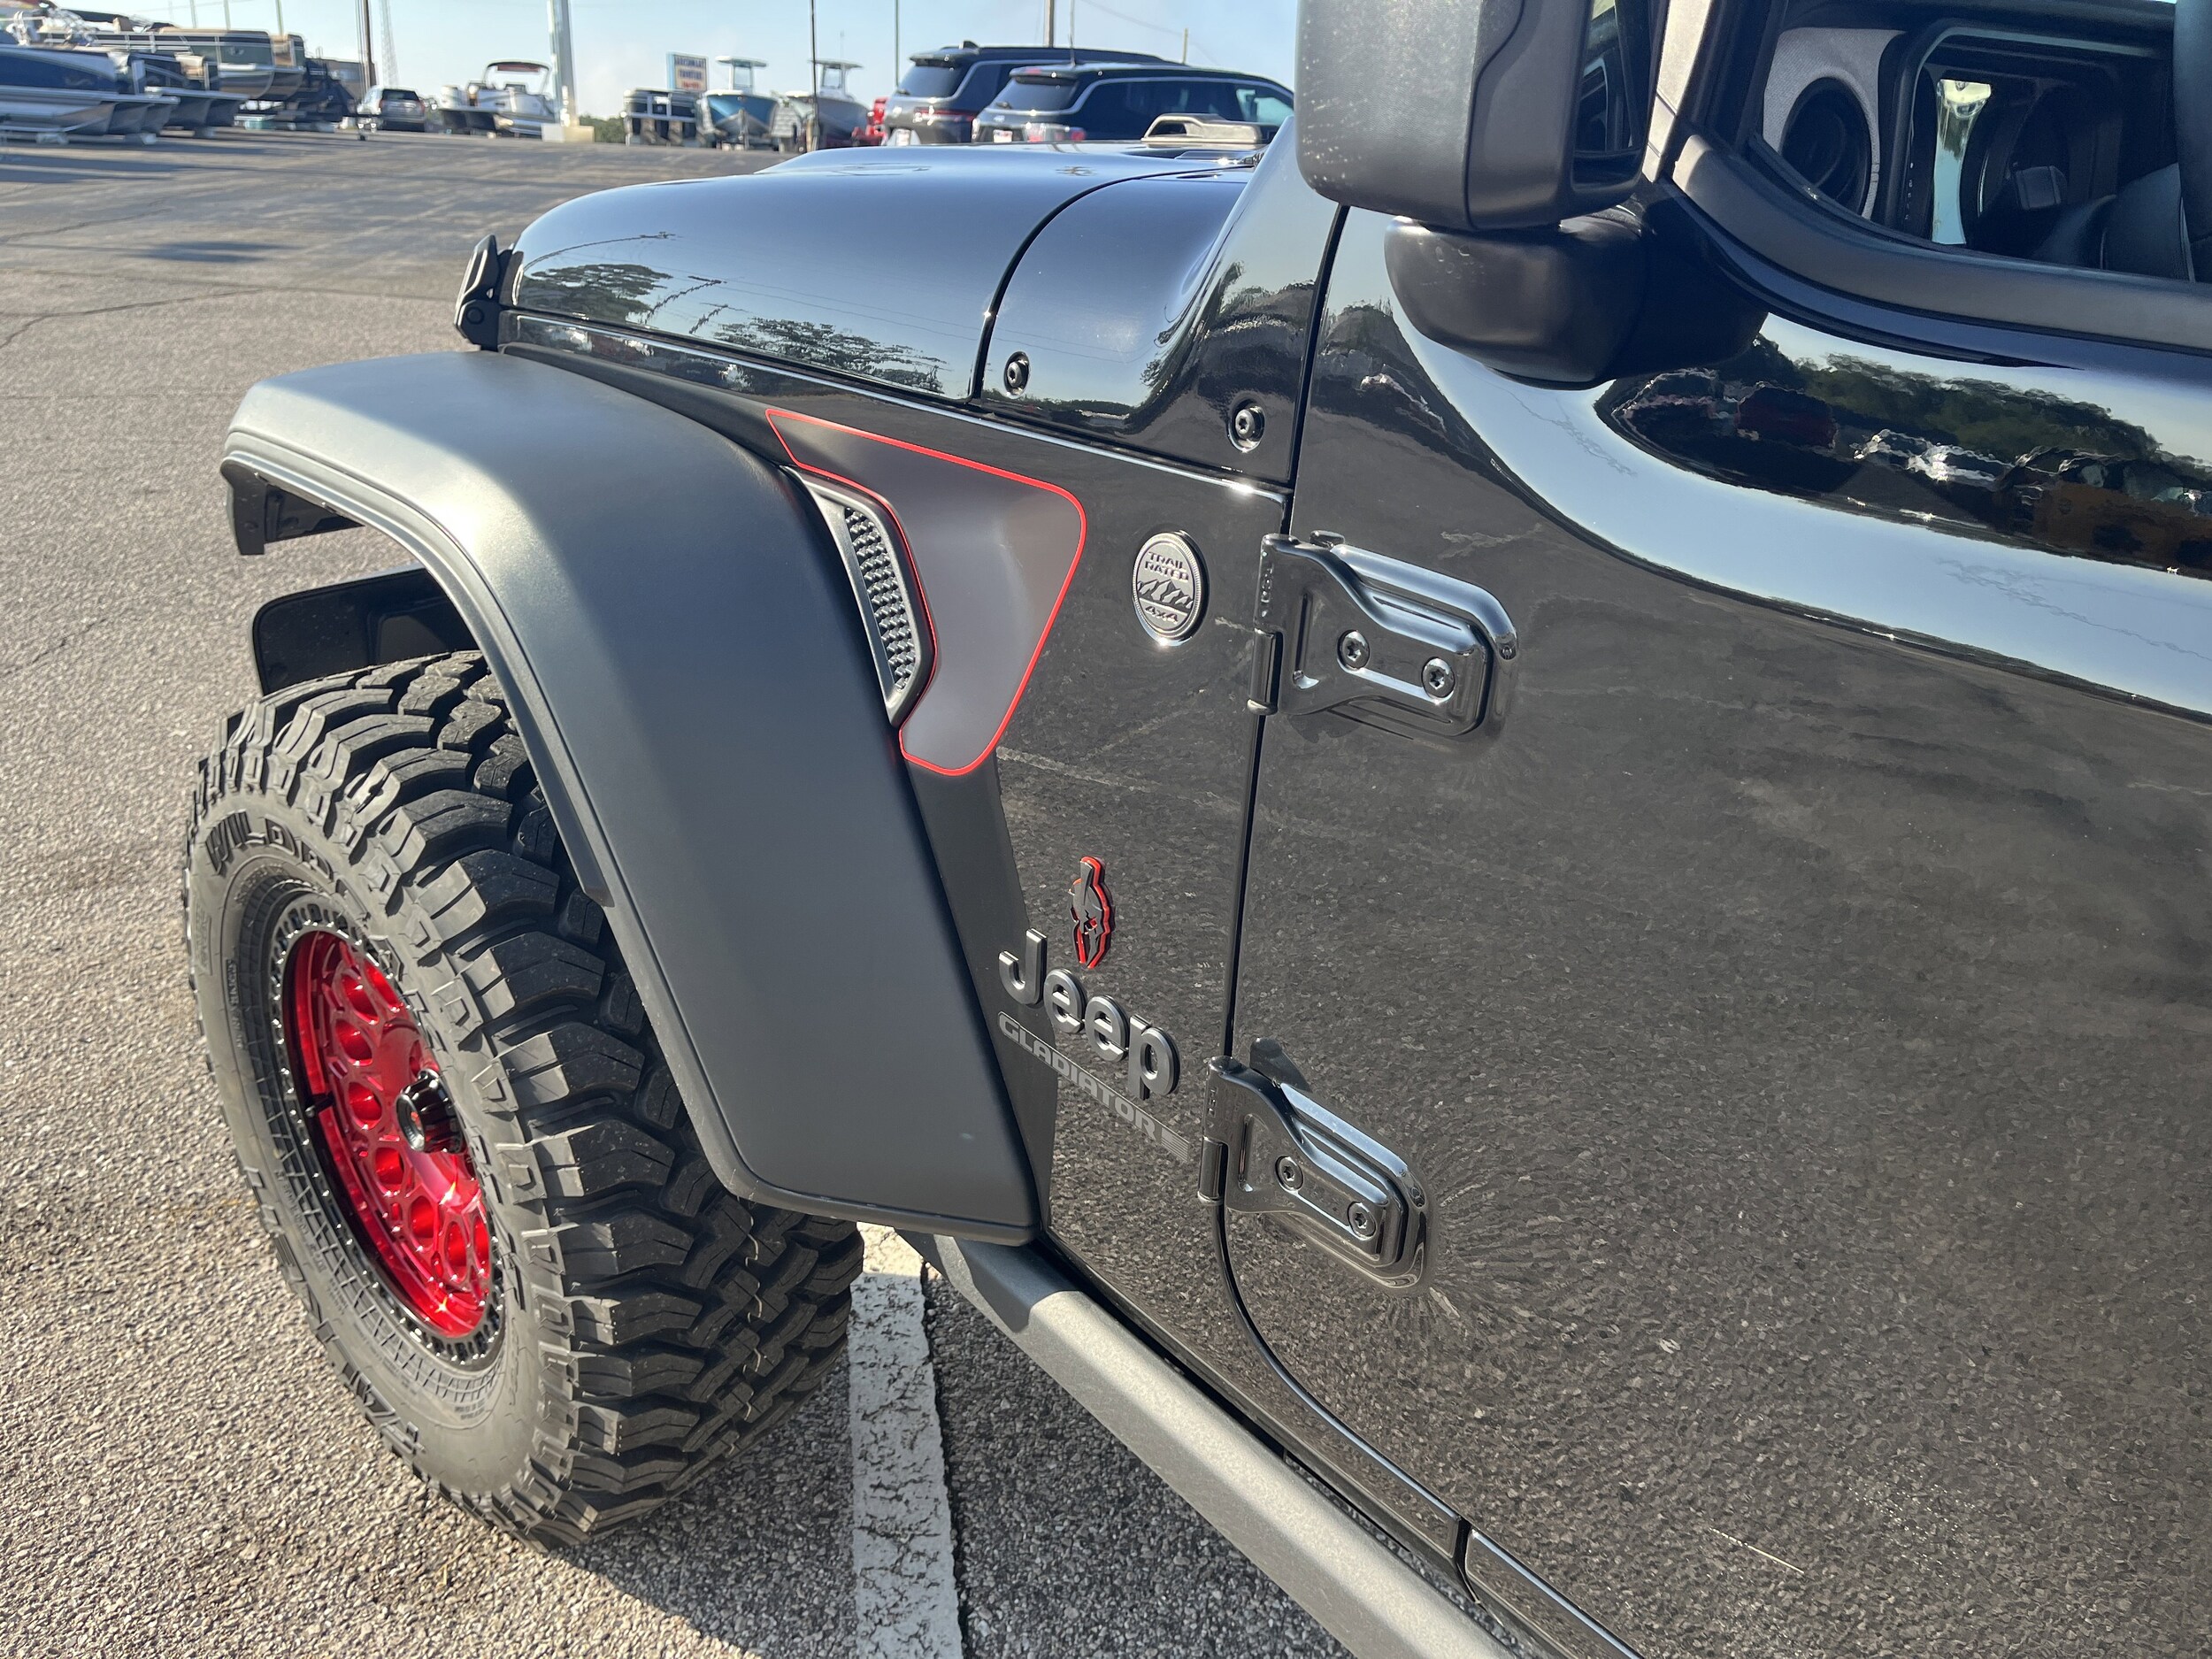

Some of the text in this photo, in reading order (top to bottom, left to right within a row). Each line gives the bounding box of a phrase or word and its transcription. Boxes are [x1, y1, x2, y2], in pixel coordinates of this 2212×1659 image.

[1144, 560, 1189, 583] RATED
[1148, 551, 1187, 572] TRAIL
[998, 928, 1180, 1100] Jeep
[999, 1016, 1157, 1141] GLADIATOR
